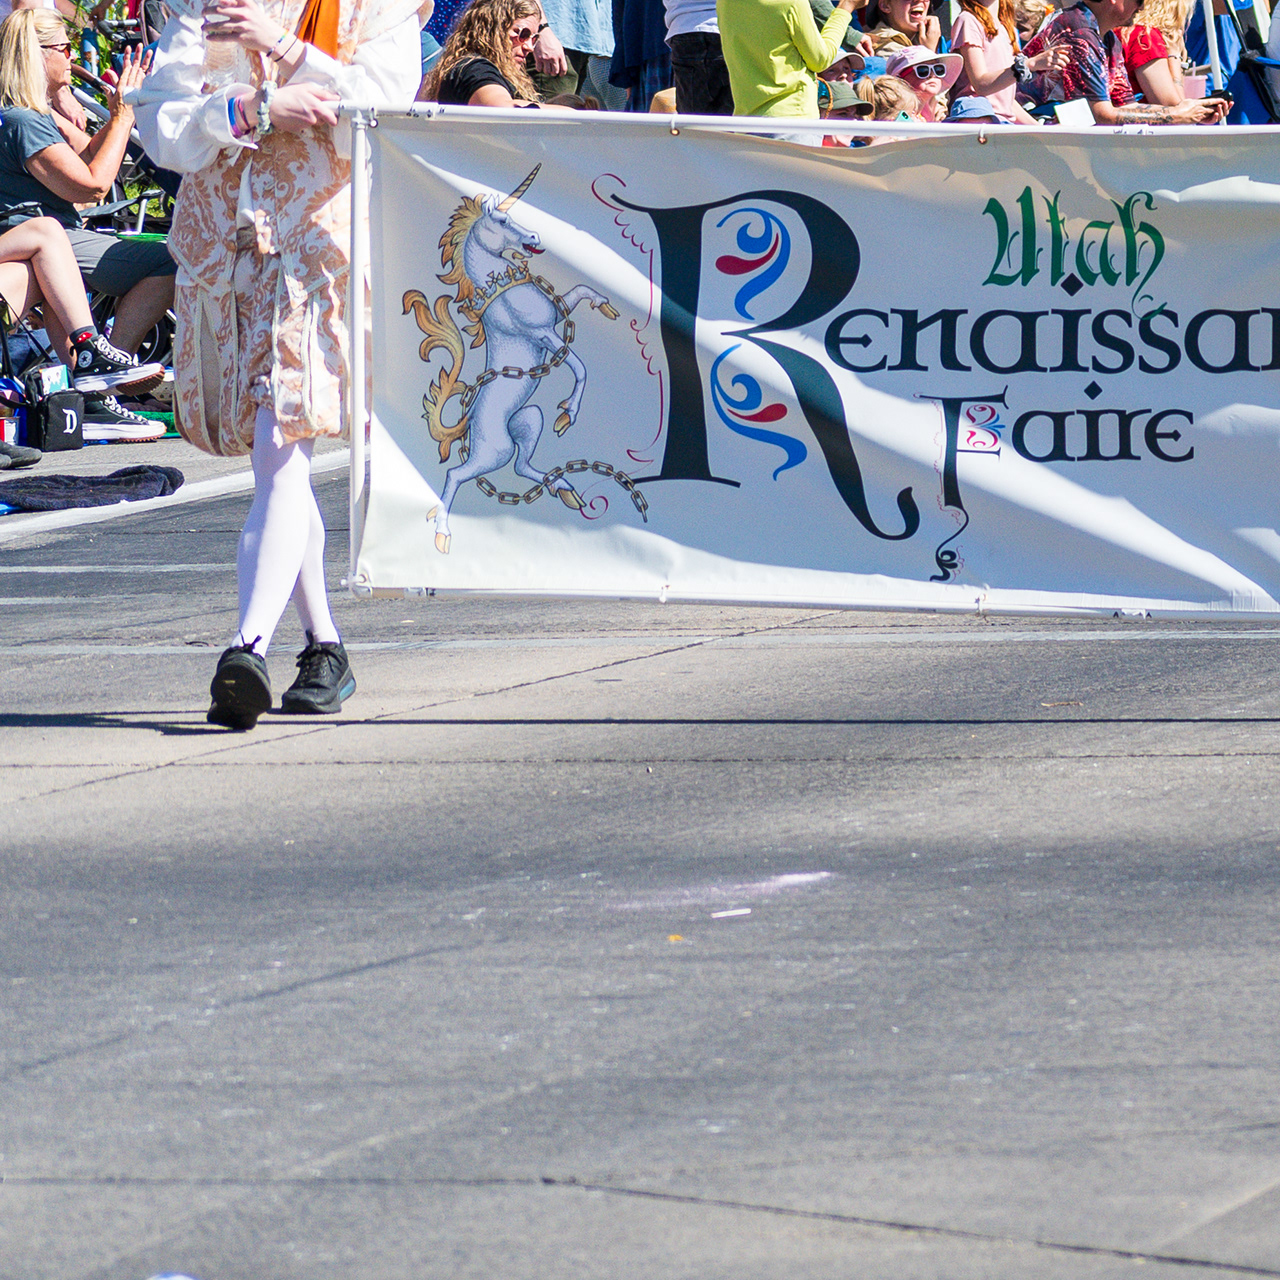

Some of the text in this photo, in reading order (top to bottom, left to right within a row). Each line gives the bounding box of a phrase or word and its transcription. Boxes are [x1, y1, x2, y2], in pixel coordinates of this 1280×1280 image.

[982, 185, 1167, 321] Utah
[62, 408, 78, 434] D
[912, 380, 1195, 581] Faire
